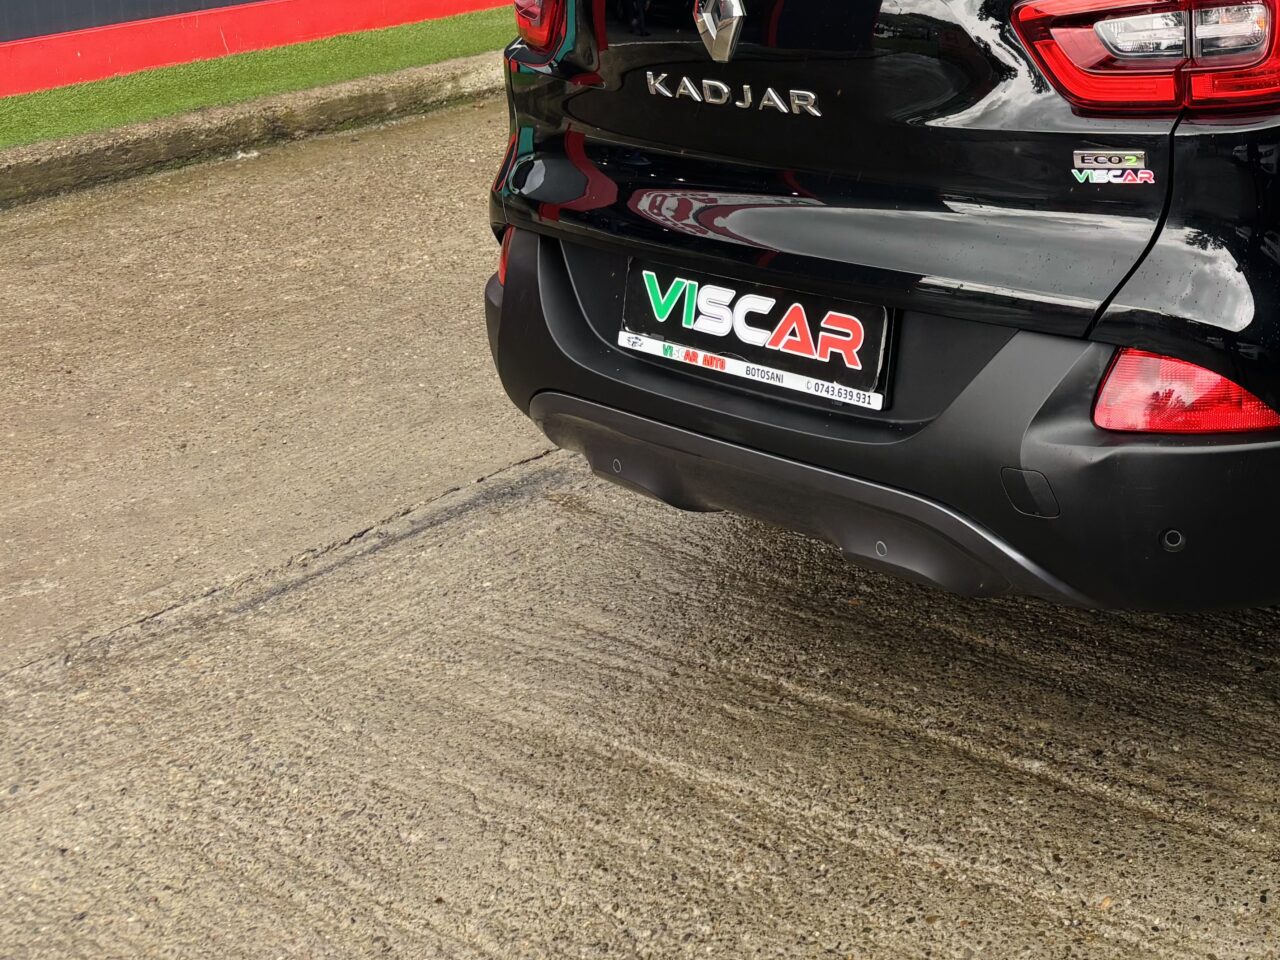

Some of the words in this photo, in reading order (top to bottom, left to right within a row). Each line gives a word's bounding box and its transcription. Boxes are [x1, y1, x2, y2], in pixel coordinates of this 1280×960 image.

[646, 71, 823, 117] KADJAR
[1080, 155, 1138, 166] ECO2
[1071, 169, 1155, 184] VISCAR
[642, 270, 864, 371] VISCAR
[662, 343, 699, 363] VISCAR
[702, 353, 726, 371] AUTO
[745, 365, 785, 384] BOTOSANI
[813, 382, 872, 405] 0743.639.931
